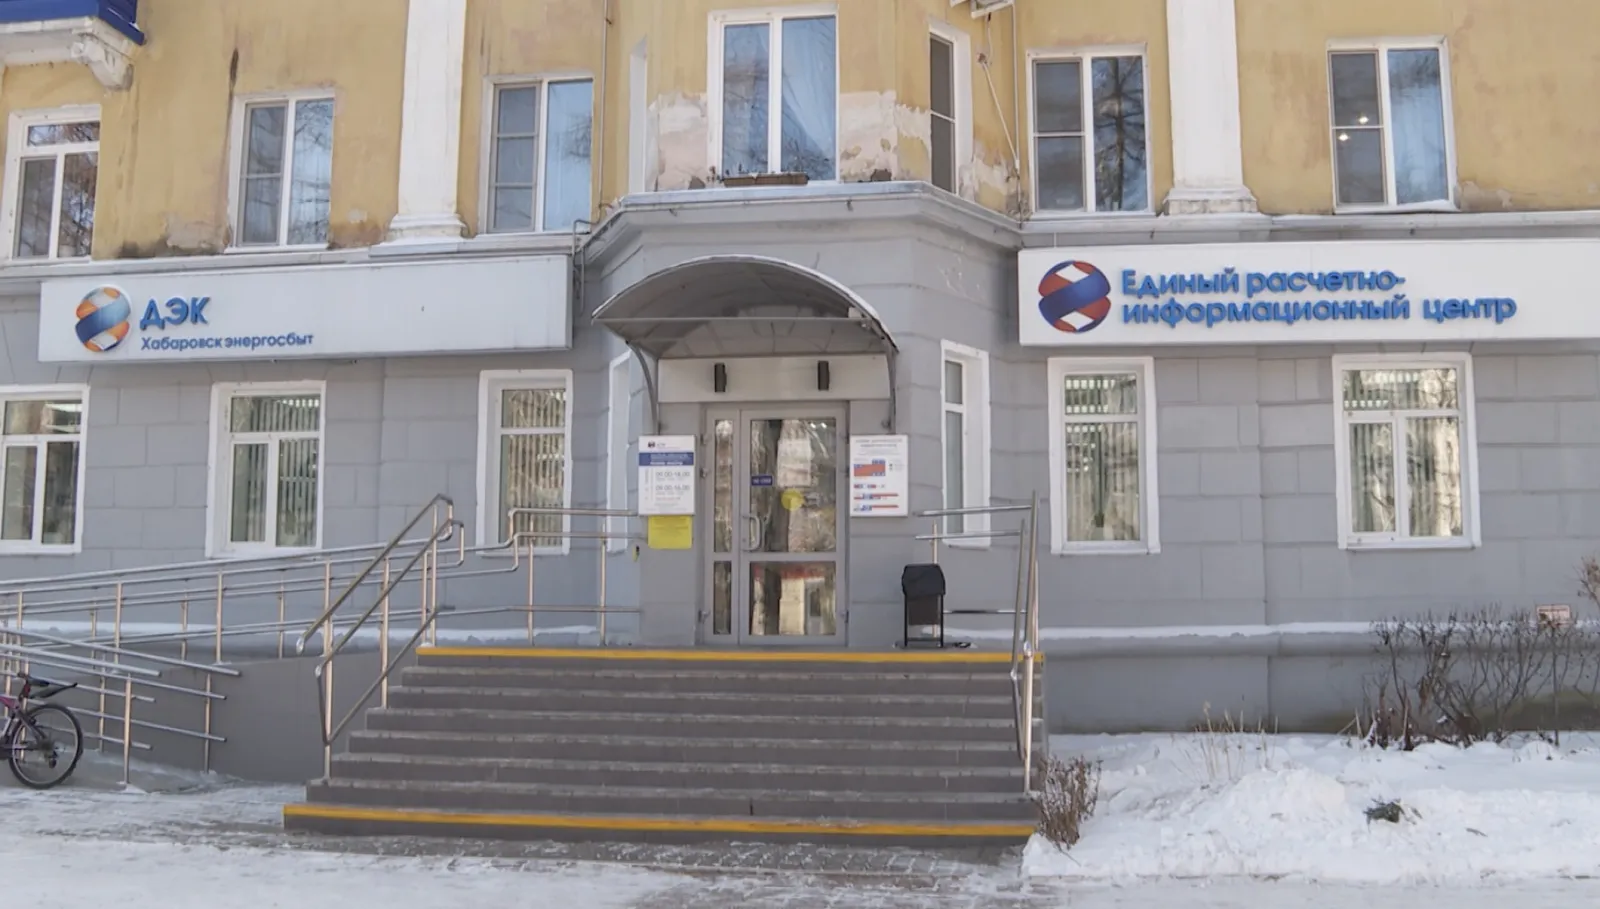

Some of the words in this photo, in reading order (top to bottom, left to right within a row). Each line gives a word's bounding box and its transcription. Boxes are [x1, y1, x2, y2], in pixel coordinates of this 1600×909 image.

[1122, 267, 1239, 299] Единый
[1246, 270, 1406, 299] расчетно-
[140, 297, 210, 331] ДЭК
[1122, 294, 1411, 329] информационный
[1422, 297, 1518, 325] центр
